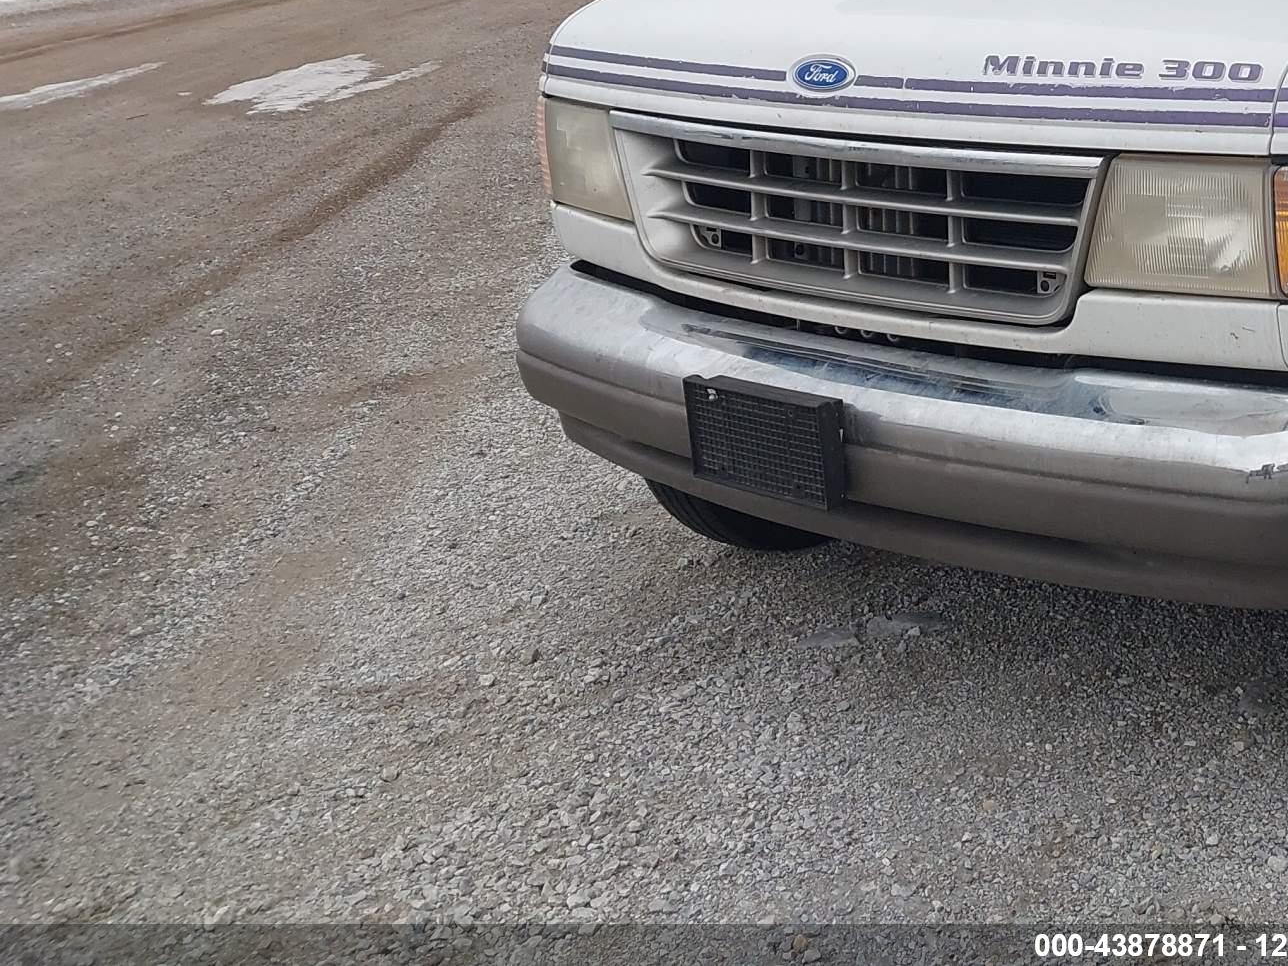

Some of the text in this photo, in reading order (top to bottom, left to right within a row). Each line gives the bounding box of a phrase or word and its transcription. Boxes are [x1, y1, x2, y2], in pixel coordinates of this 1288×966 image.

[804, 63, 840, 83] Ford
[983, 55, 1264, 82] Minnie 300
